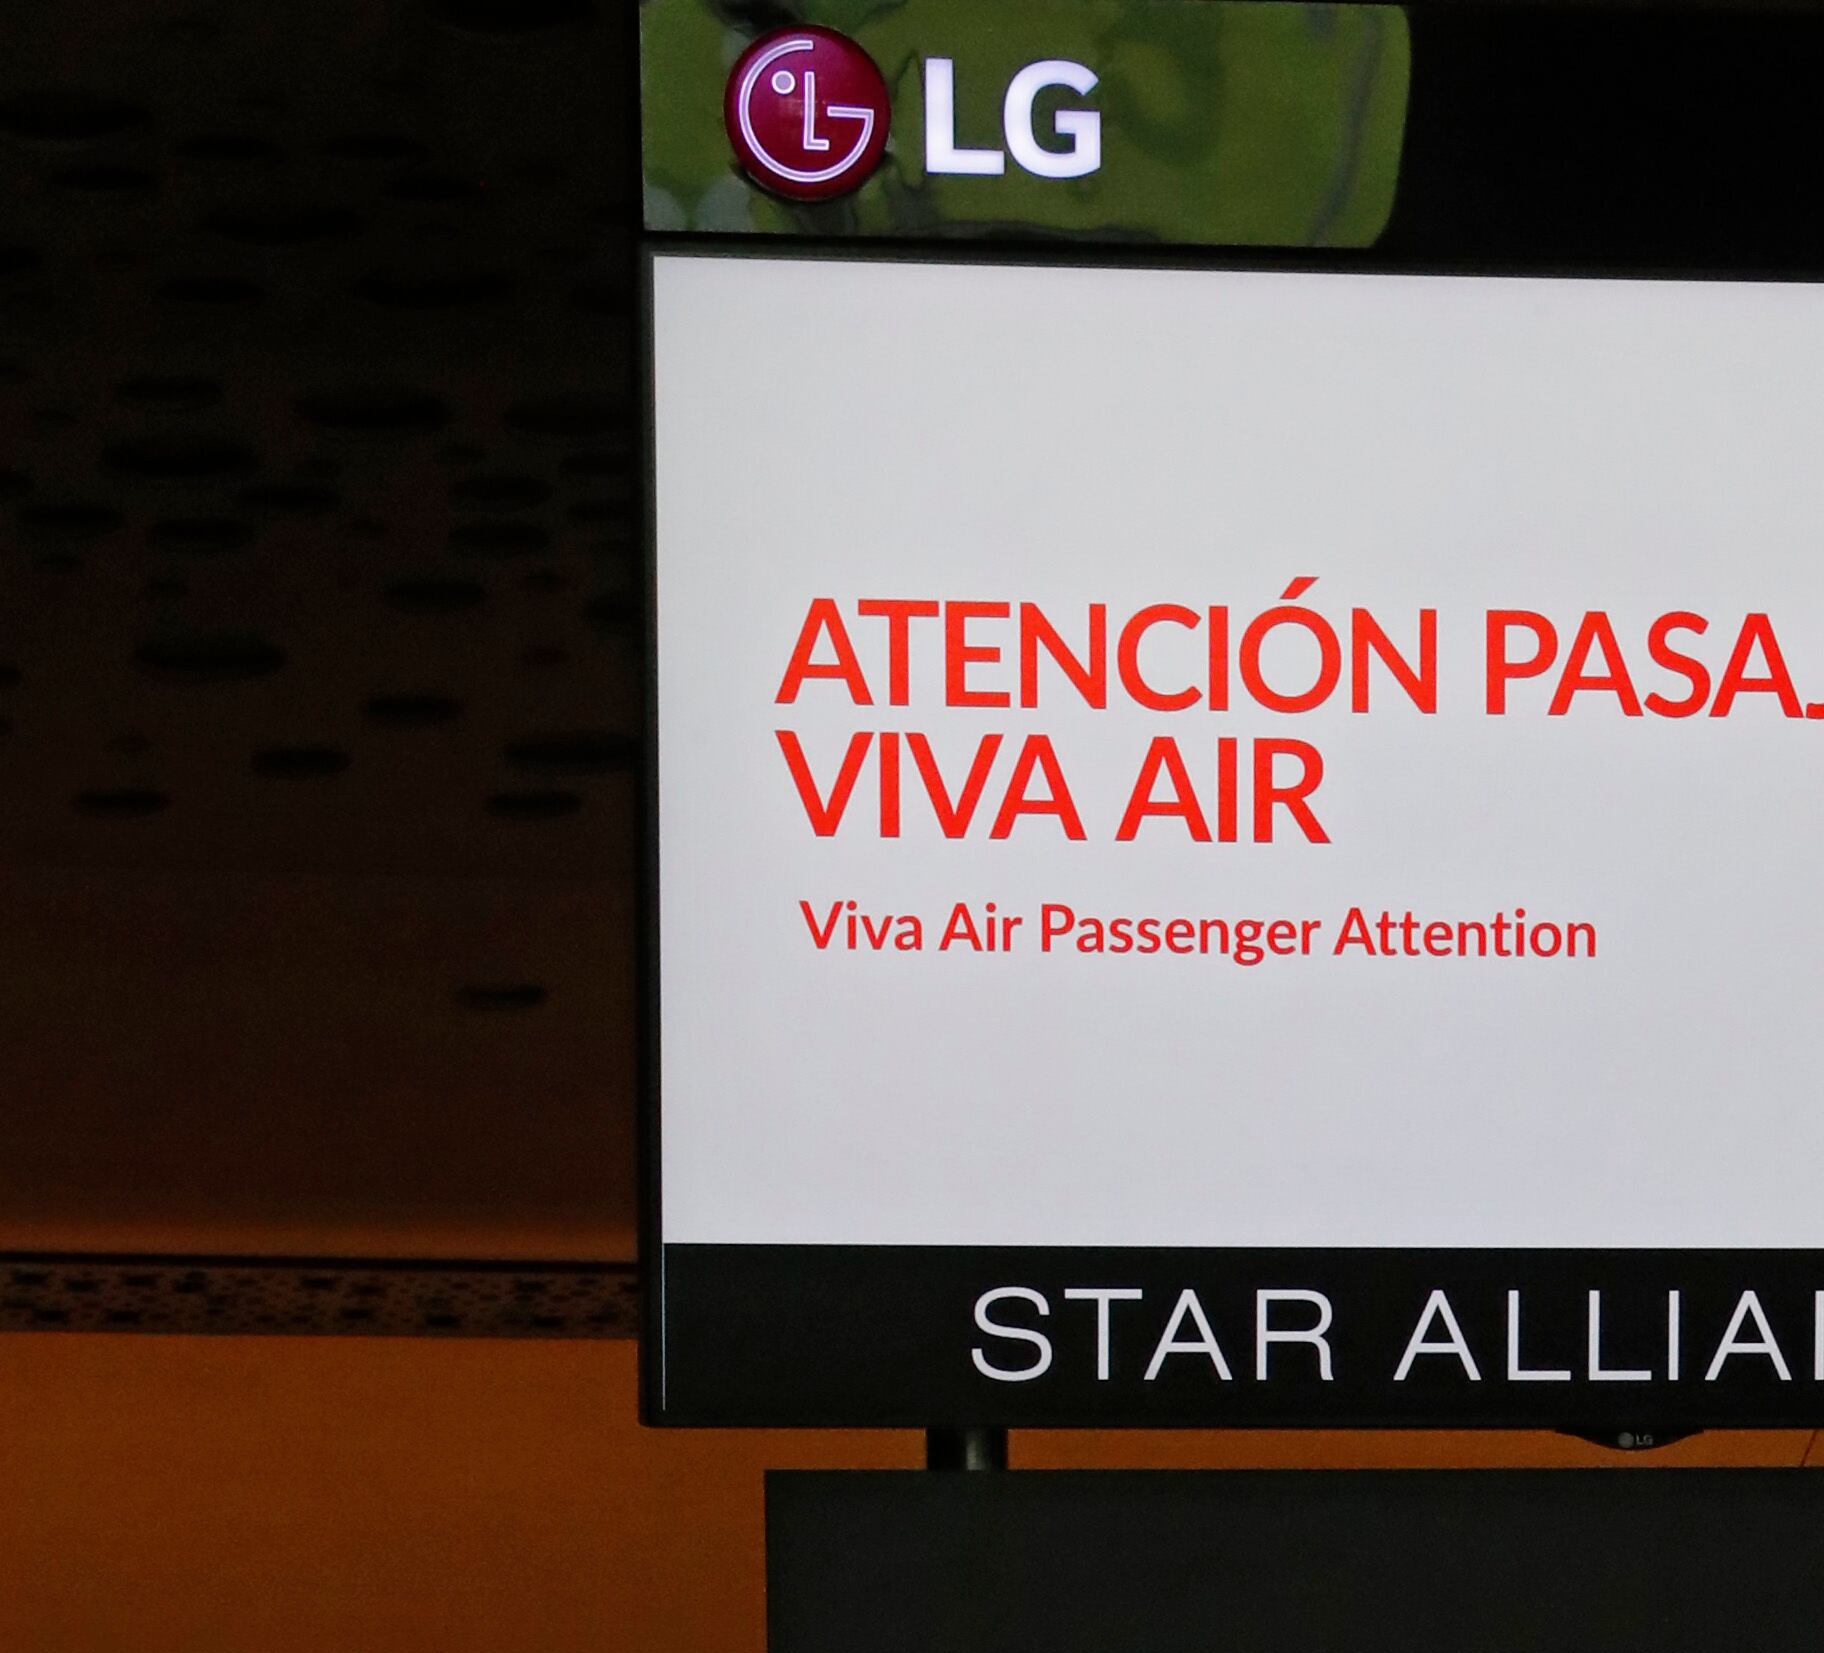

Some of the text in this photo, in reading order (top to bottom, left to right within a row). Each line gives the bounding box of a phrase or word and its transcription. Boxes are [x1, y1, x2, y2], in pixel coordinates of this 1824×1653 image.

[924, 57, 1102, 179] LG
[775, 576, 1437, 714] ATENCIÓN
[774, 729, 1331, 844] VIVA AIR
[799, 899, 1597, 967] Viva Air Passenger Attention
[970, 1286, 1334, 1383] STAR
